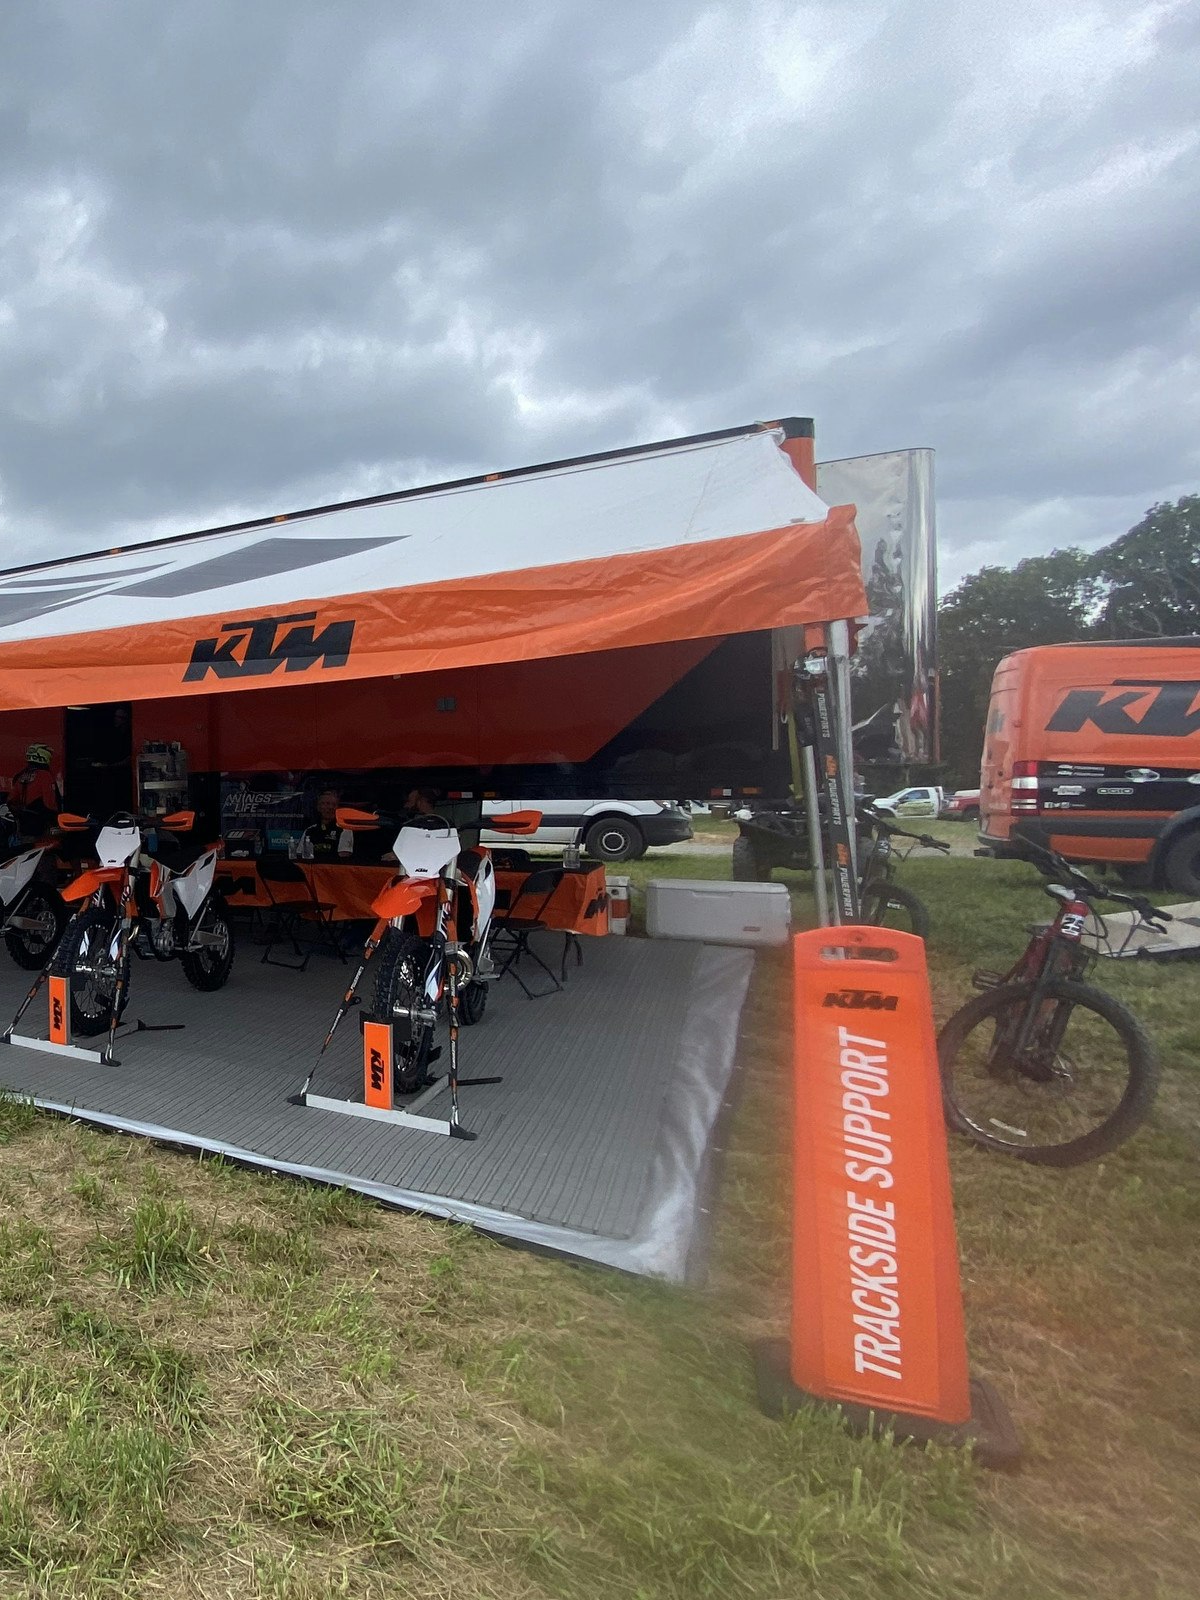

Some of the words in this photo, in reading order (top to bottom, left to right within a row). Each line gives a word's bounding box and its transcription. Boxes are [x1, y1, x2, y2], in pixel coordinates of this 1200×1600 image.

[182, 611, 355, 682] KTM
[1044, 679, 1200, 737] KT
[234, 803, 258, 812] LIFE
[53, 997, 62, 1030] KTM
[822, 989, 898, 1011] KTM
[371, 1048, 384, 1090] KTM
[838, 1026, 893, 1189] SUPPORT
[847, 1192, 902, 1380] TRACKSIDE
